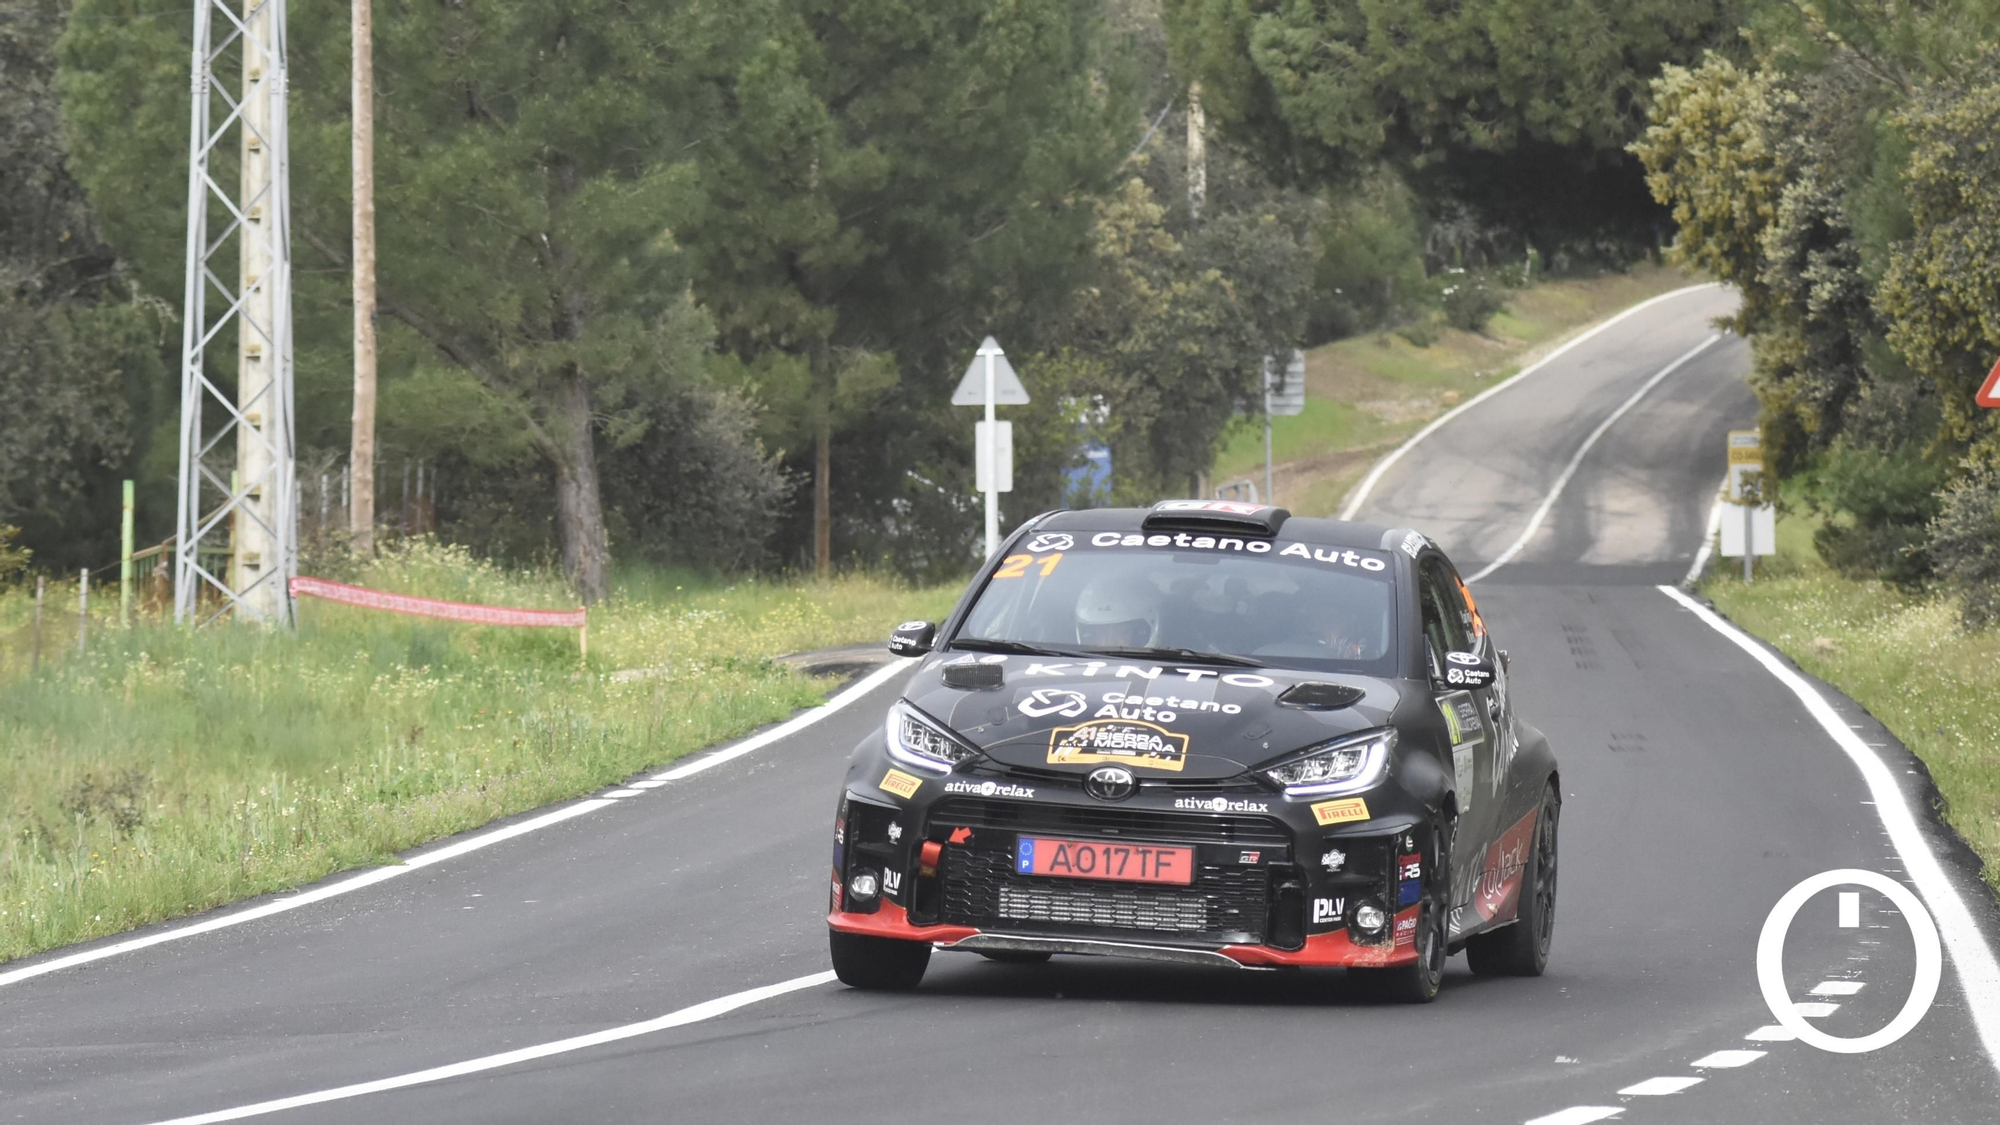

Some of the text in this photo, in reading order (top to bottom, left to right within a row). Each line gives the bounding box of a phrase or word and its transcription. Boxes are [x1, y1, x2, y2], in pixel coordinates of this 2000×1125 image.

[1091, 532, 1272, 553] Caetano
[1279, 542, 1386, 572] Auto
[993, 552, 1064, 579] 21
[1024, 661, 1275, 688] KINTO
[1464, 669, 1490, 678] Caetano
[1464, 677, 1482, 685] Auto
[1102, 691, 1242, 714] Caetano
[1094, 705, 1177, 723] Auto
[1093, 739, 1176, 753] MORENA
[1095, 732, 1163, 744] SIERRA
[884, 774, 916, 794] PIRELLI
[1318, 802, 1364, 820] PIRELLI
[1021, 860, 1030, 869] P
[883, 867, 902, 891] PLV
[1313, 897, 1345, 924] PLV
